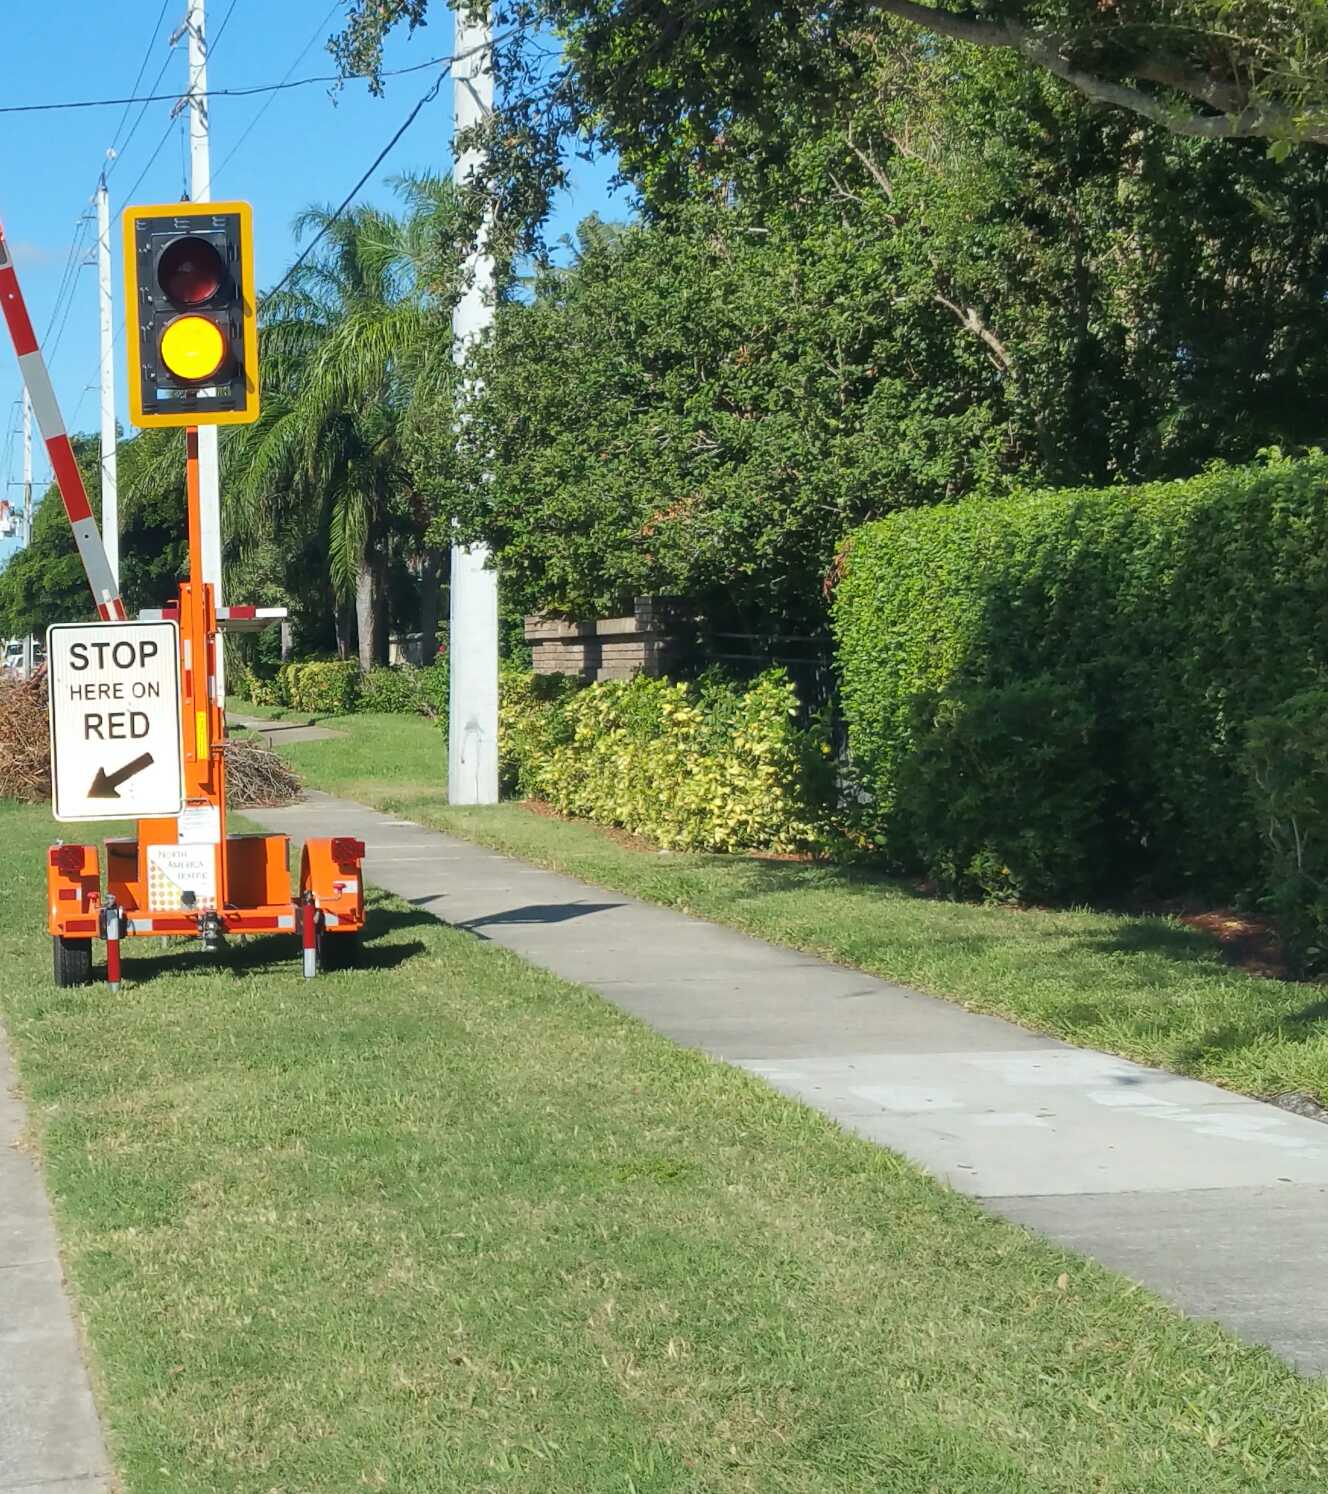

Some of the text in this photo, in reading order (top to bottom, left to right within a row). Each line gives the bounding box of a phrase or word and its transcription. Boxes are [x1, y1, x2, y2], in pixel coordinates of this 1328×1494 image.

[69, 640, 158, 671] STOP
[70, 681, 160, 701] HERE ON
[84, 711, 150, 740] RED
